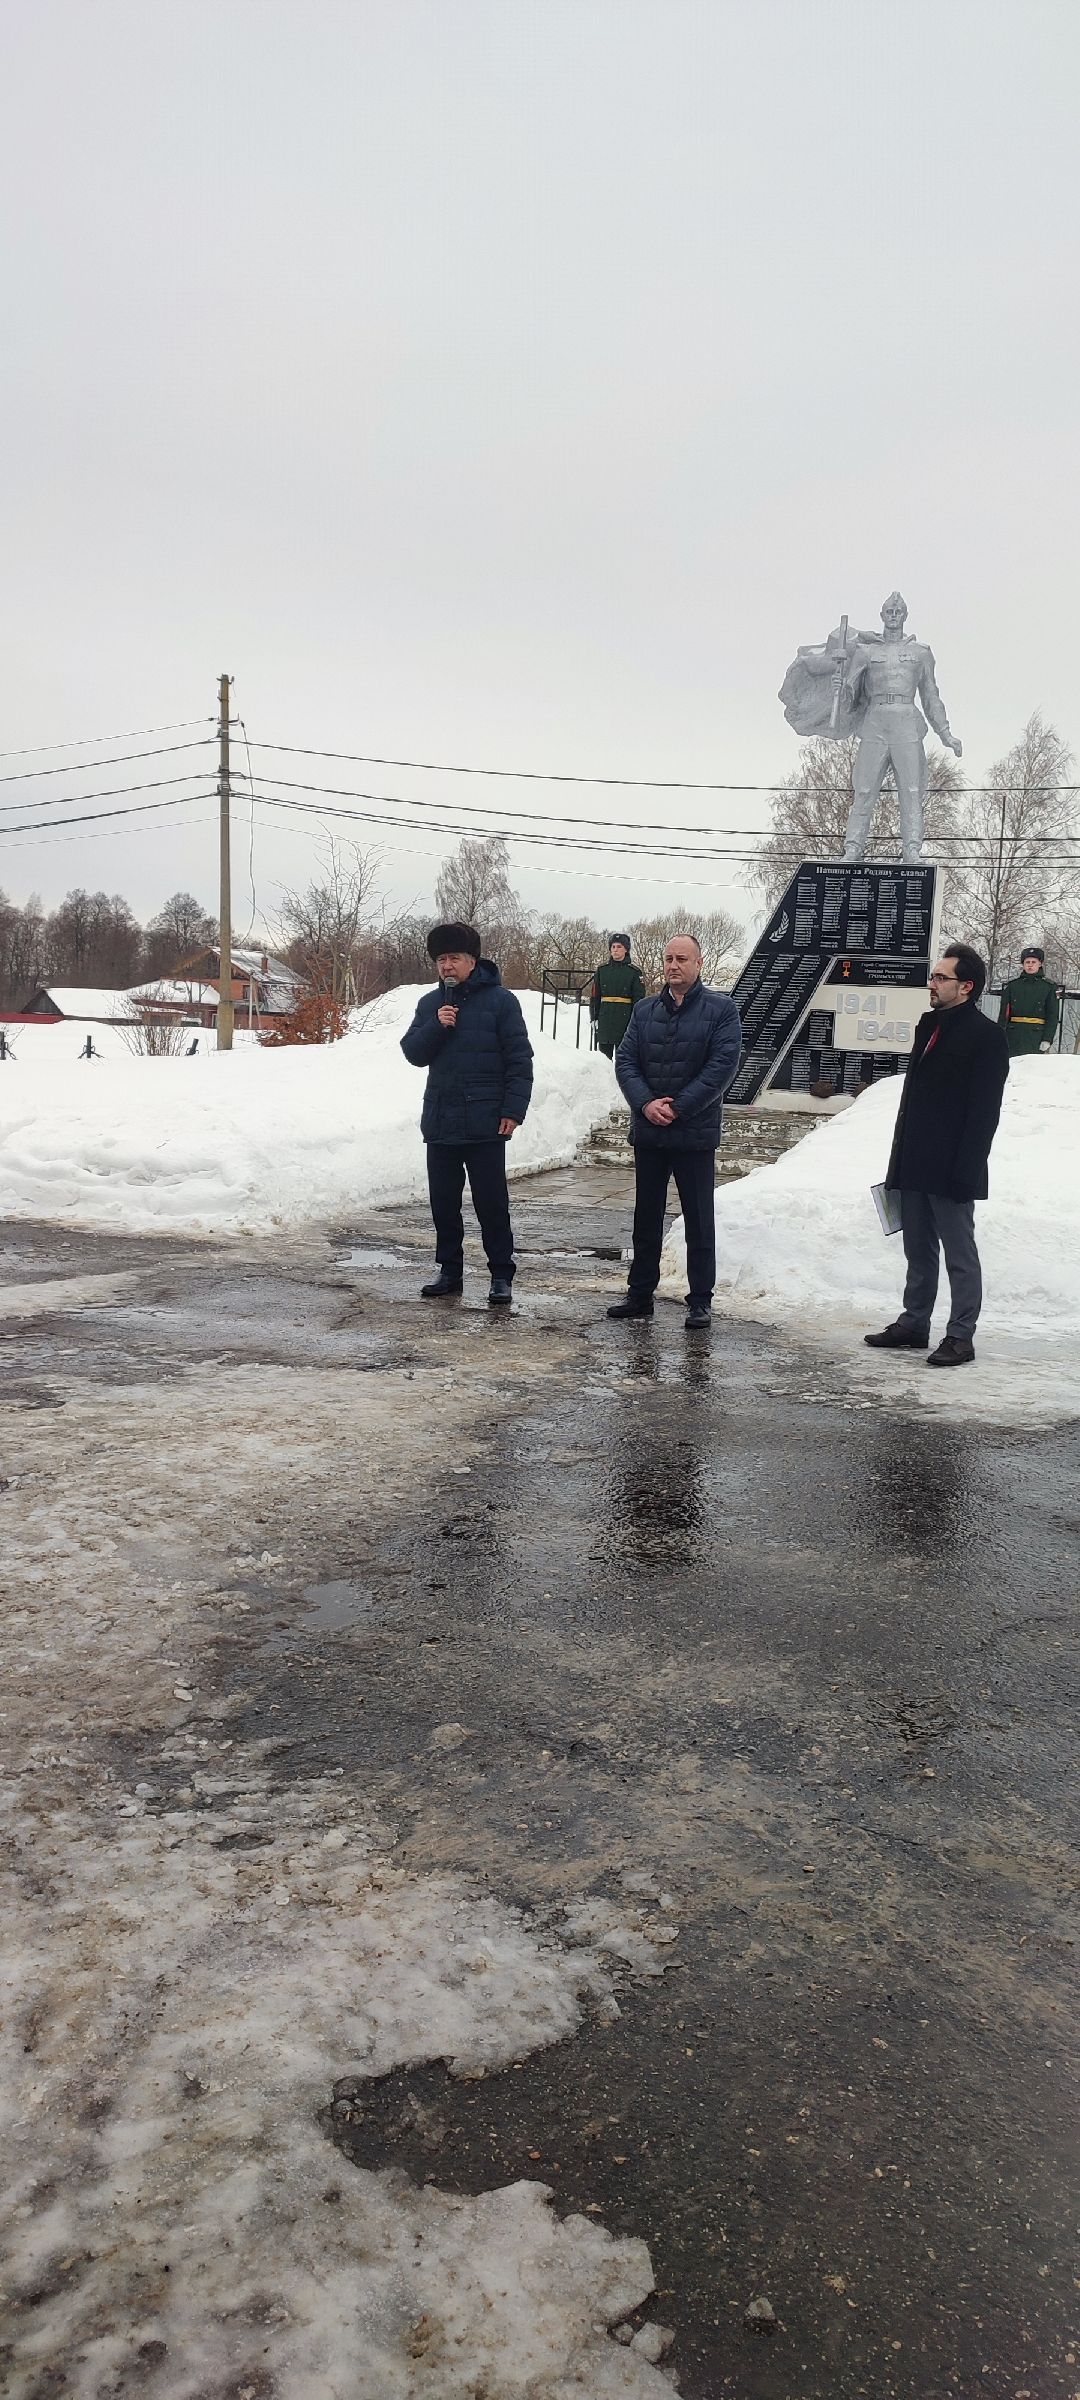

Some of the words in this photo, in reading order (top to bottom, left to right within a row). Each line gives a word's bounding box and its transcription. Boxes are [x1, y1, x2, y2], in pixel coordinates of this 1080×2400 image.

[864, 868, 893, 877] Родину
[836, 992, 886, 1015] 1941
[857, 1019, 911, 1042] 1945
